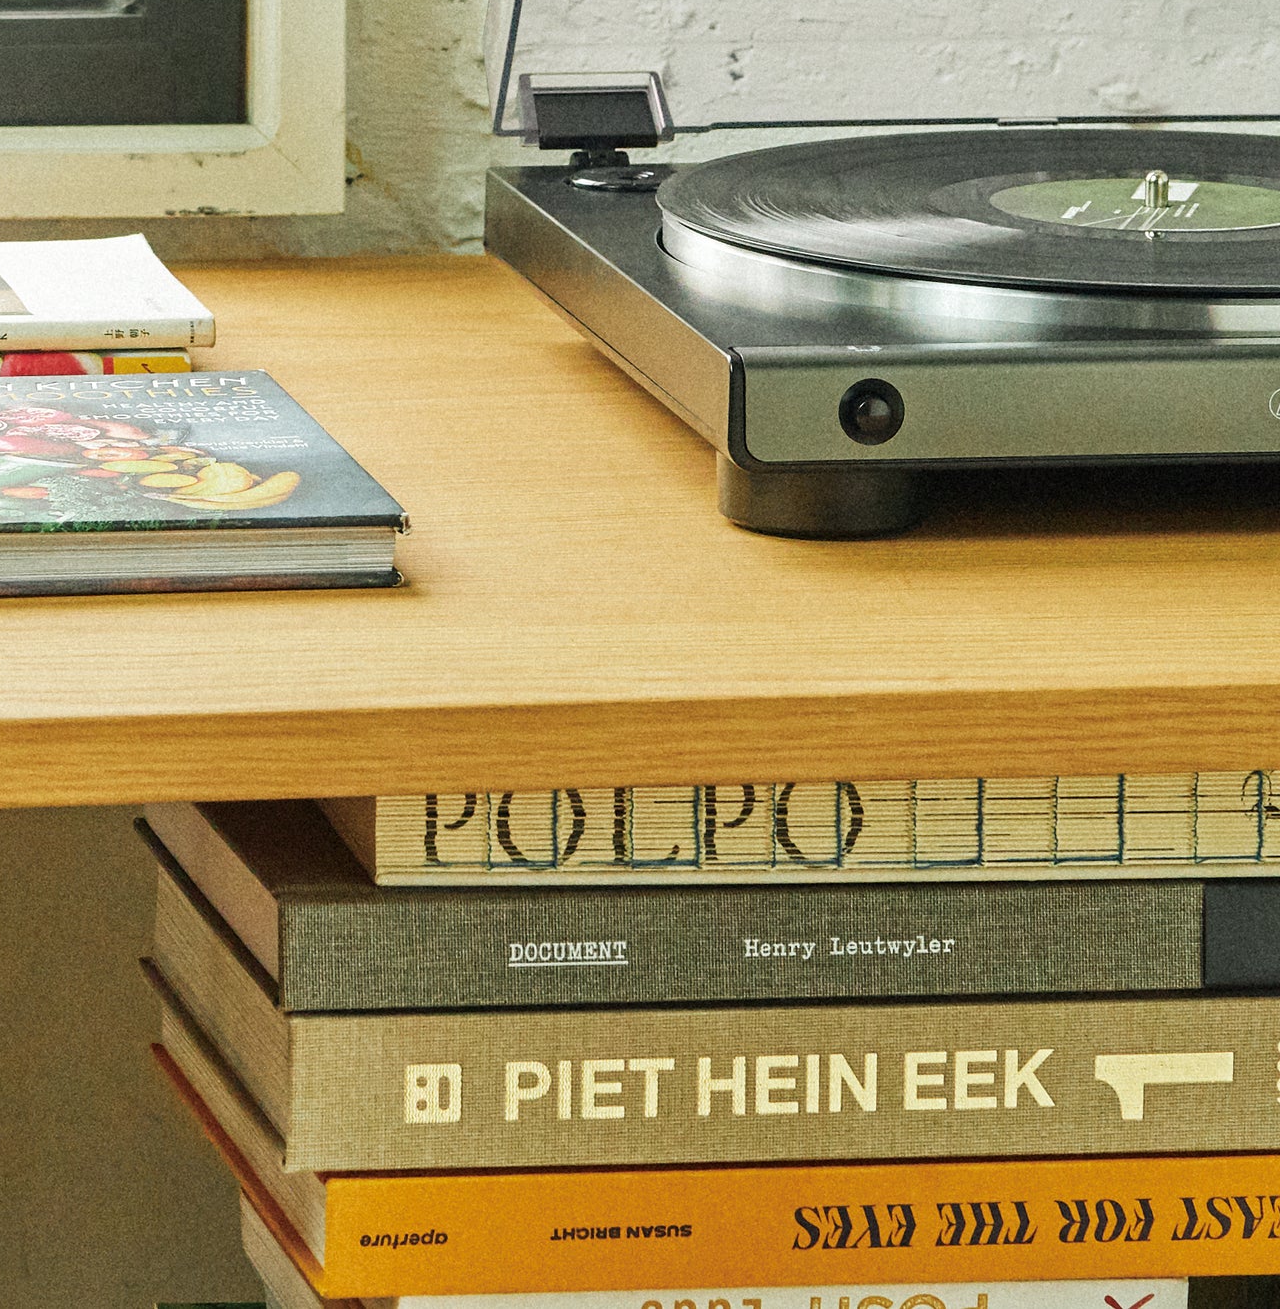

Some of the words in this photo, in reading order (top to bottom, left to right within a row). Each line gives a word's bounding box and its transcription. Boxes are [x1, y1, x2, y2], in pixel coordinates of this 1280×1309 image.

[36, 376, 247, 392] KITCHEN
[102, 400, 208, 409] HEALTHY
[217, 399, 266, 407] AND
[155, 416, 226, 424] EVERY
[424, 781, 863, 868] POLPO
[509, 941, 628, 963] DOCUMENT
[744, 939, 816, 960] Henry
[829, 936, 956, 959] Leutwyler
[505, 1057, 675, 1121] PIET
[697, 1052, 878, 1116] HEIN
[903, 1047, 1056, 1111] EEK
[626, 1224, 693, 1239] SUSAN
[790, 1202, 915, 1251] EYES
[935, 1200, 1038, 1247] THE
[1054, 1197, 1155, 1244] FOR
[360, 1229, 449, 1251] aperture
[550, 1226, 621, 1241] BRIGHT
